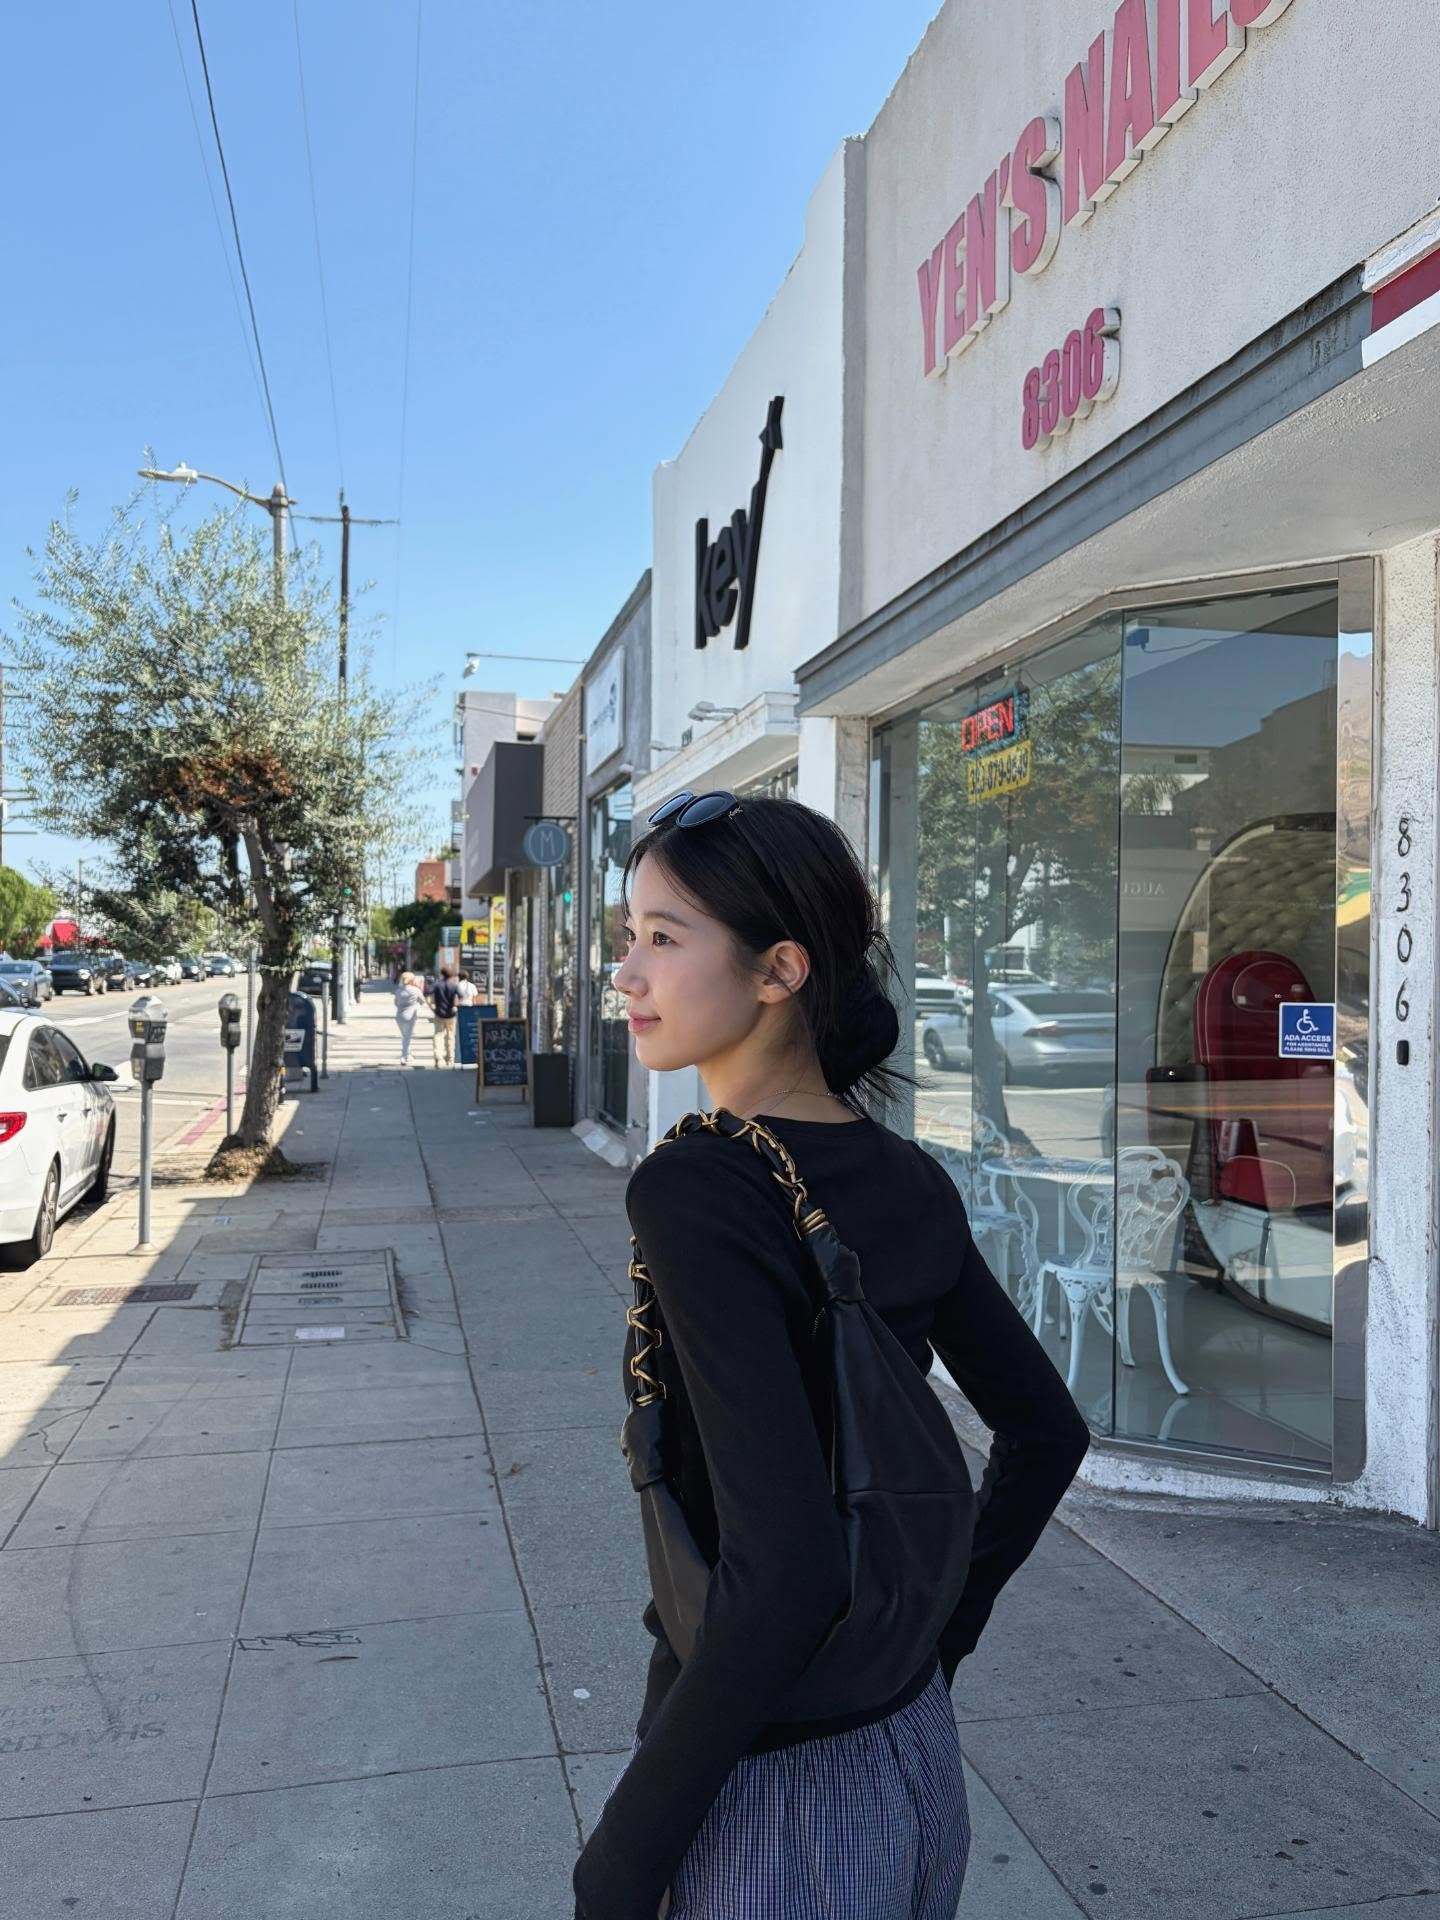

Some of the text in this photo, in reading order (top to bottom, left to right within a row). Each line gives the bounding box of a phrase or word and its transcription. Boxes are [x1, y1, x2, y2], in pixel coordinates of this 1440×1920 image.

[917, 0, 1292, 377] YEN'S NAIL
[1022, 307, 1119, 450] 8306
[961, 697, 1014, 752] OPEN
[1395, 817, 1412, 1022] 8306
